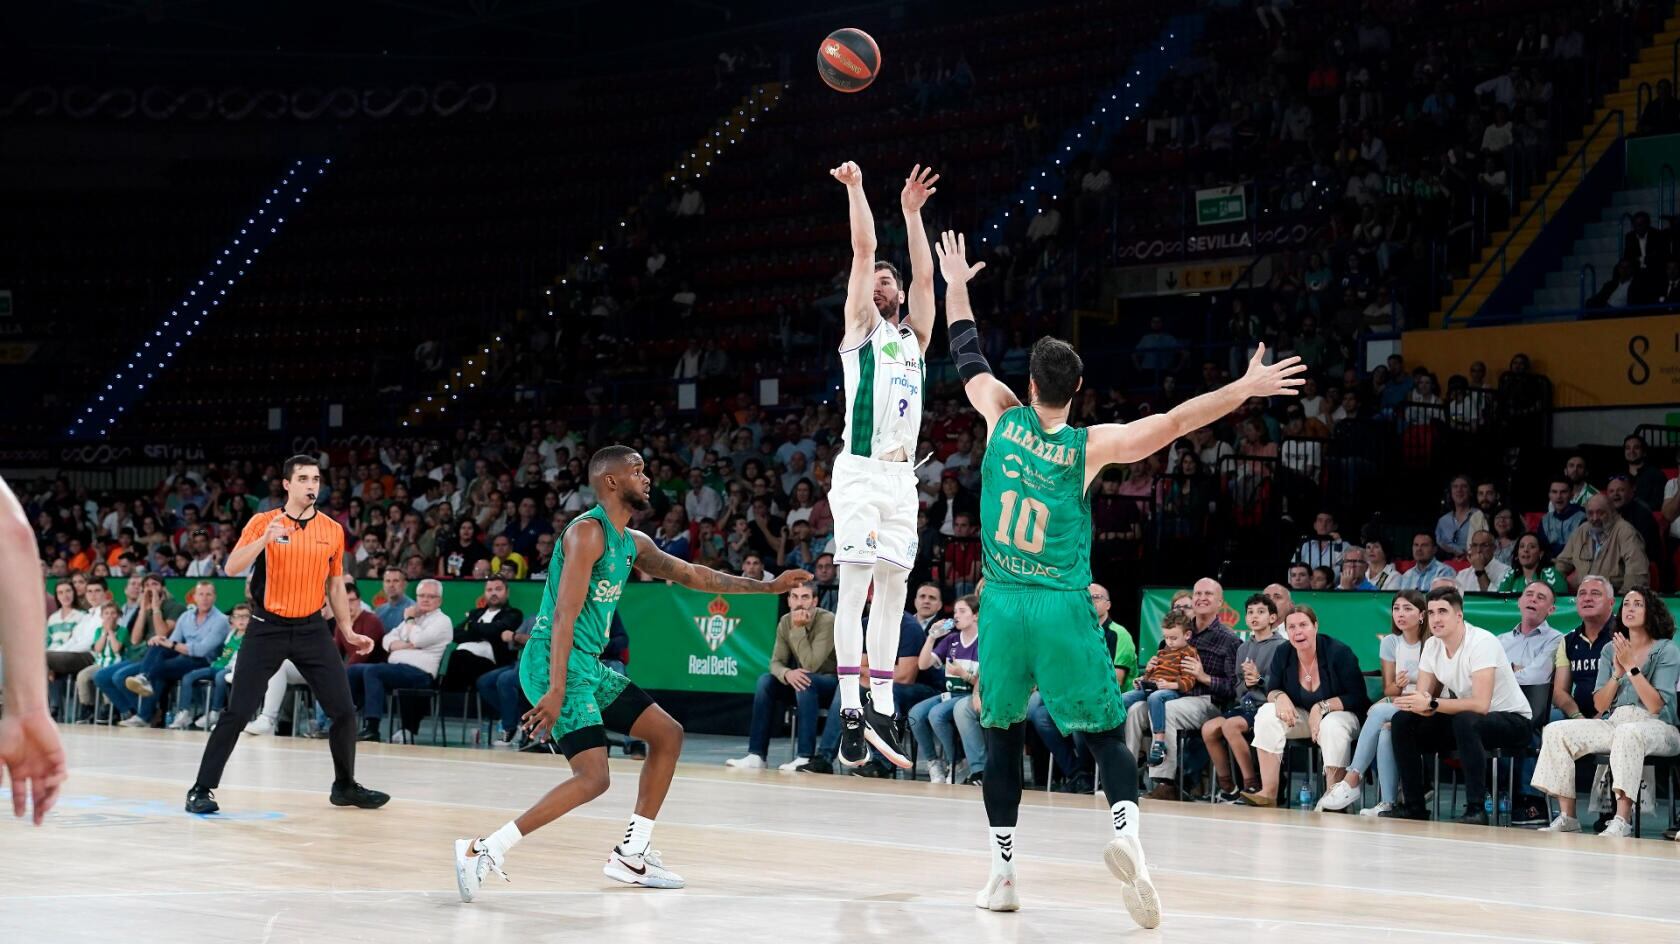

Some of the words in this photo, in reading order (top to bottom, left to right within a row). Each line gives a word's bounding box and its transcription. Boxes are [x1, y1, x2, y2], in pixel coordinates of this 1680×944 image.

[1187, 231, 1250, 252] SEVILLA
[994, 490, 1051, 554] 10
[994, 552, 1062, 578] MEDAC
